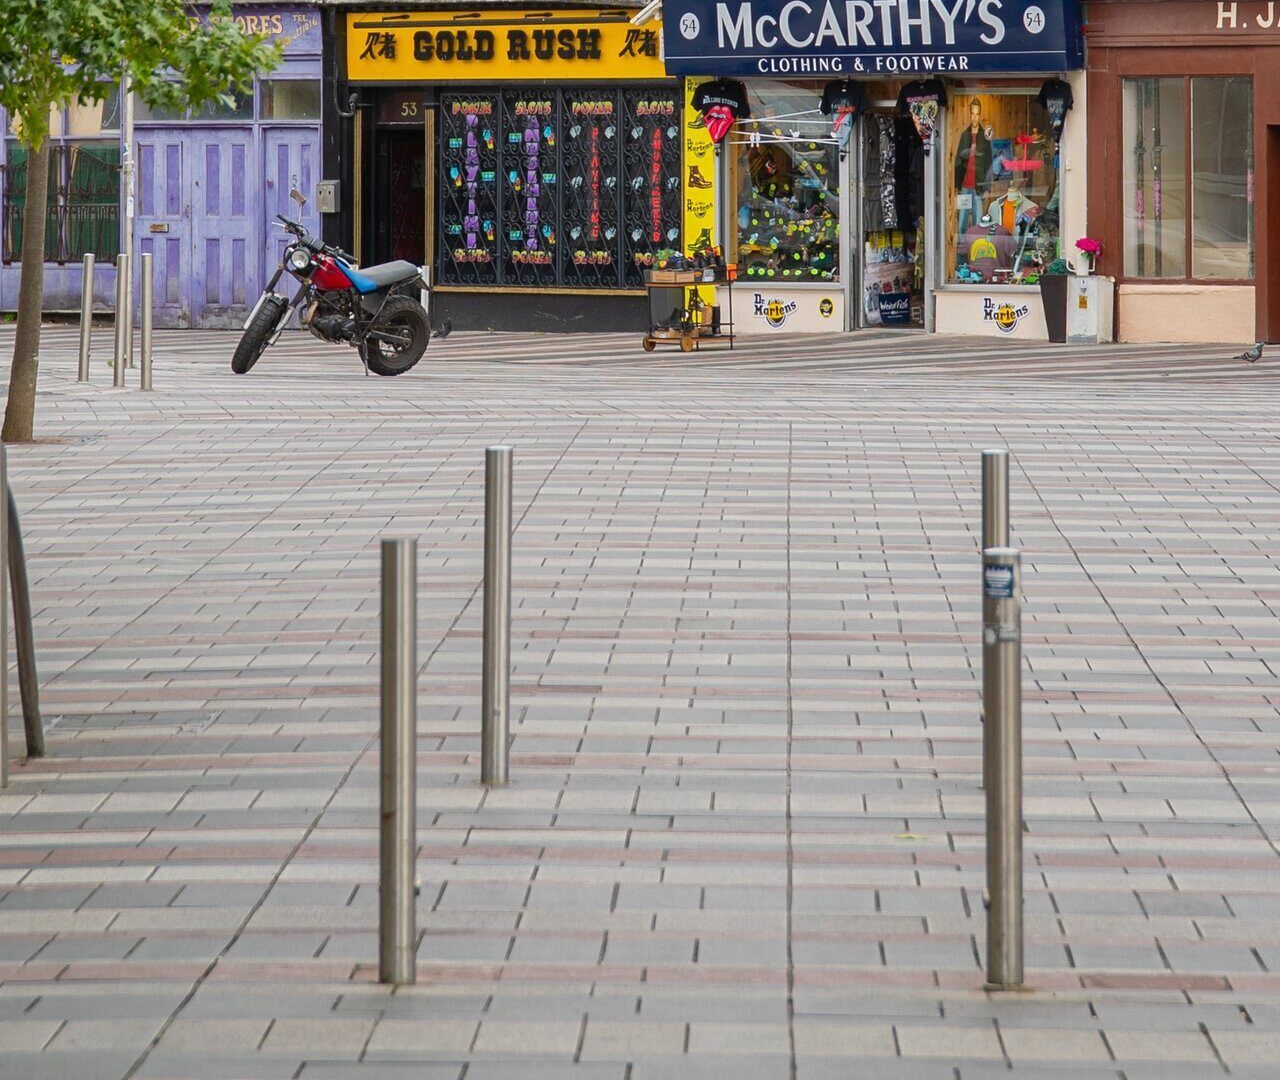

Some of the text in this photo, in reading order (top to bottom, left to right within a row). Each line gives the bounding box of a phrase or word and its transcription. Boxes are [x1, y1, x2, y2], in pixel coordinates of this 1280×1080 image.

[1026, 11, 1043, 27] 54
[1216, 1, 1248, 29] H.
[210, 14, 283, 36] ORES
[292, 14, 308, 22] TEL
[681, 18, 697, 33] 54
[413, 28, 602, 61] GOLD RUSH
[758, 55, 970, 73] CLOTHING & FOOTWEAR
[401, 102, 418, 116] 53
[452, 101, 492, 115] POKER
[515, 101, 552, 115] SLOTS
[572, 101, 614, 115] POKER
[636, 101, 674, 115] SLOTS
[754, 301, 797, 316] Martens
[984, 305, 1029, 320] Martens
